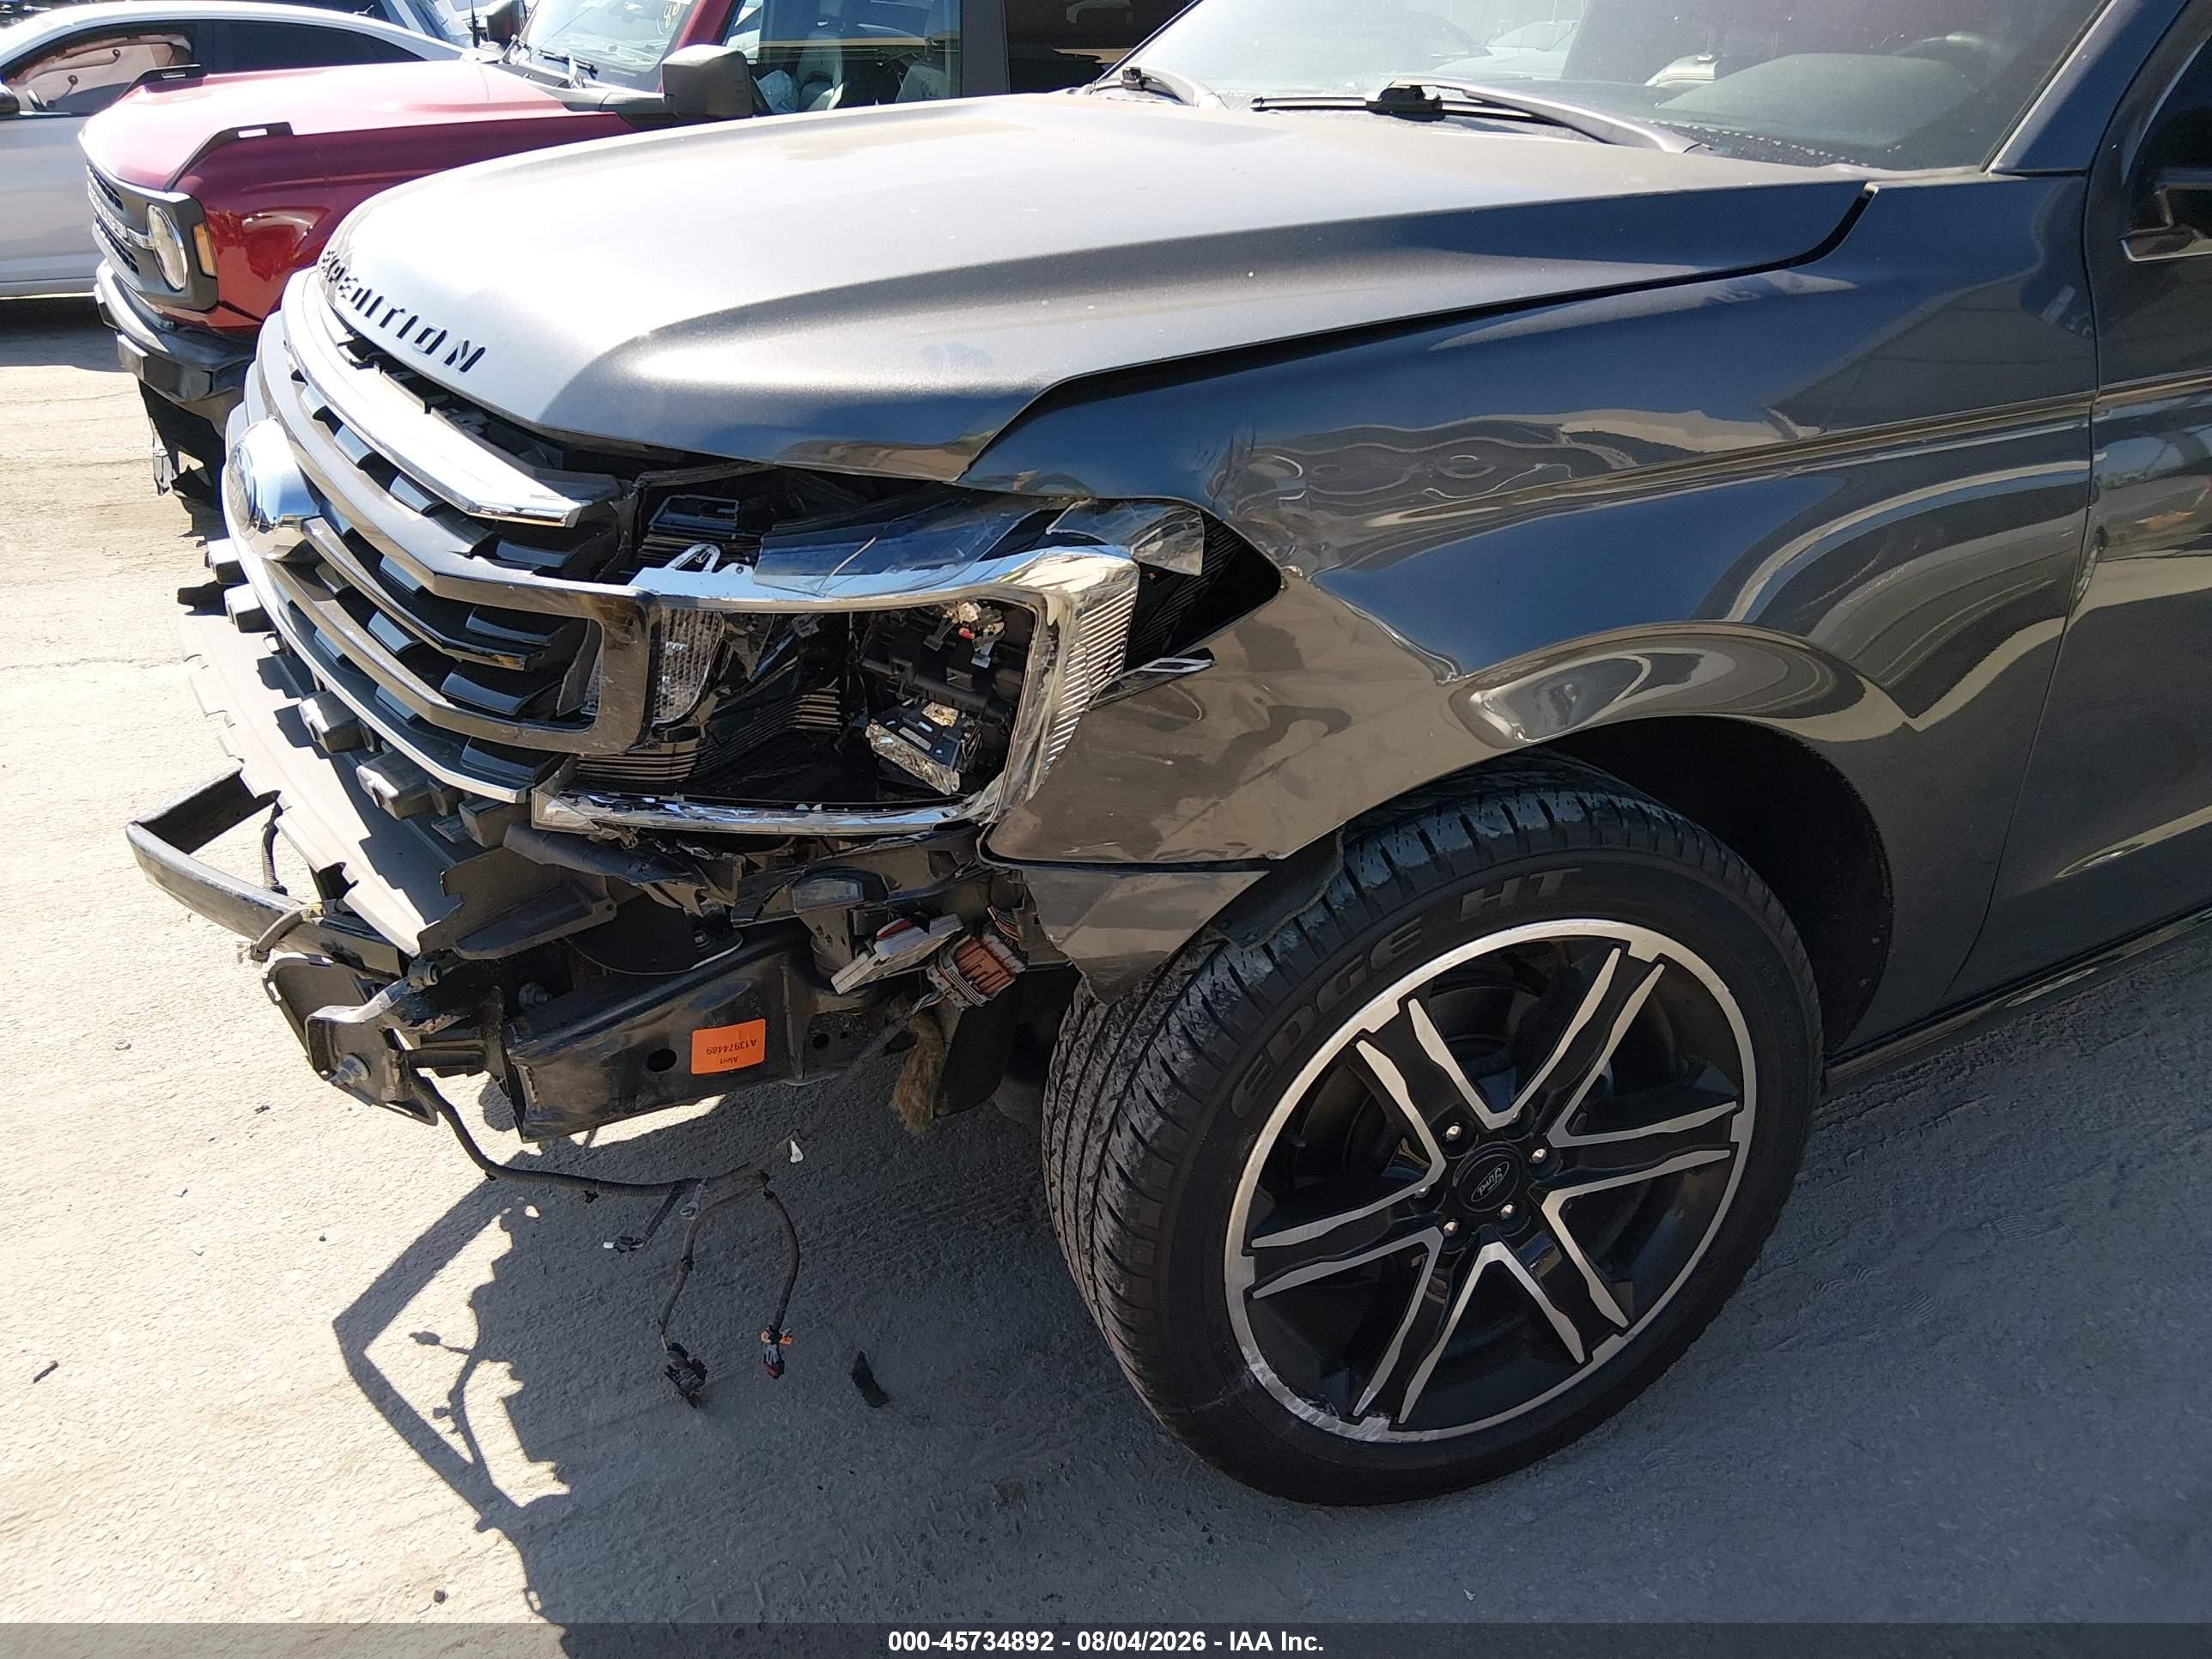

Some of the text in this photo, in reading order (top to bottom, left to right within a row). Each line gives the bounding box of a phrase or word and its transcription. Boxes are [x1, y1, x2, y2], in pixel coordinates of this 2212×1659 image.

[1231, 866, 1583, 1116] EDGE HT
[1477, 1167, 1504, 1195] Ford
